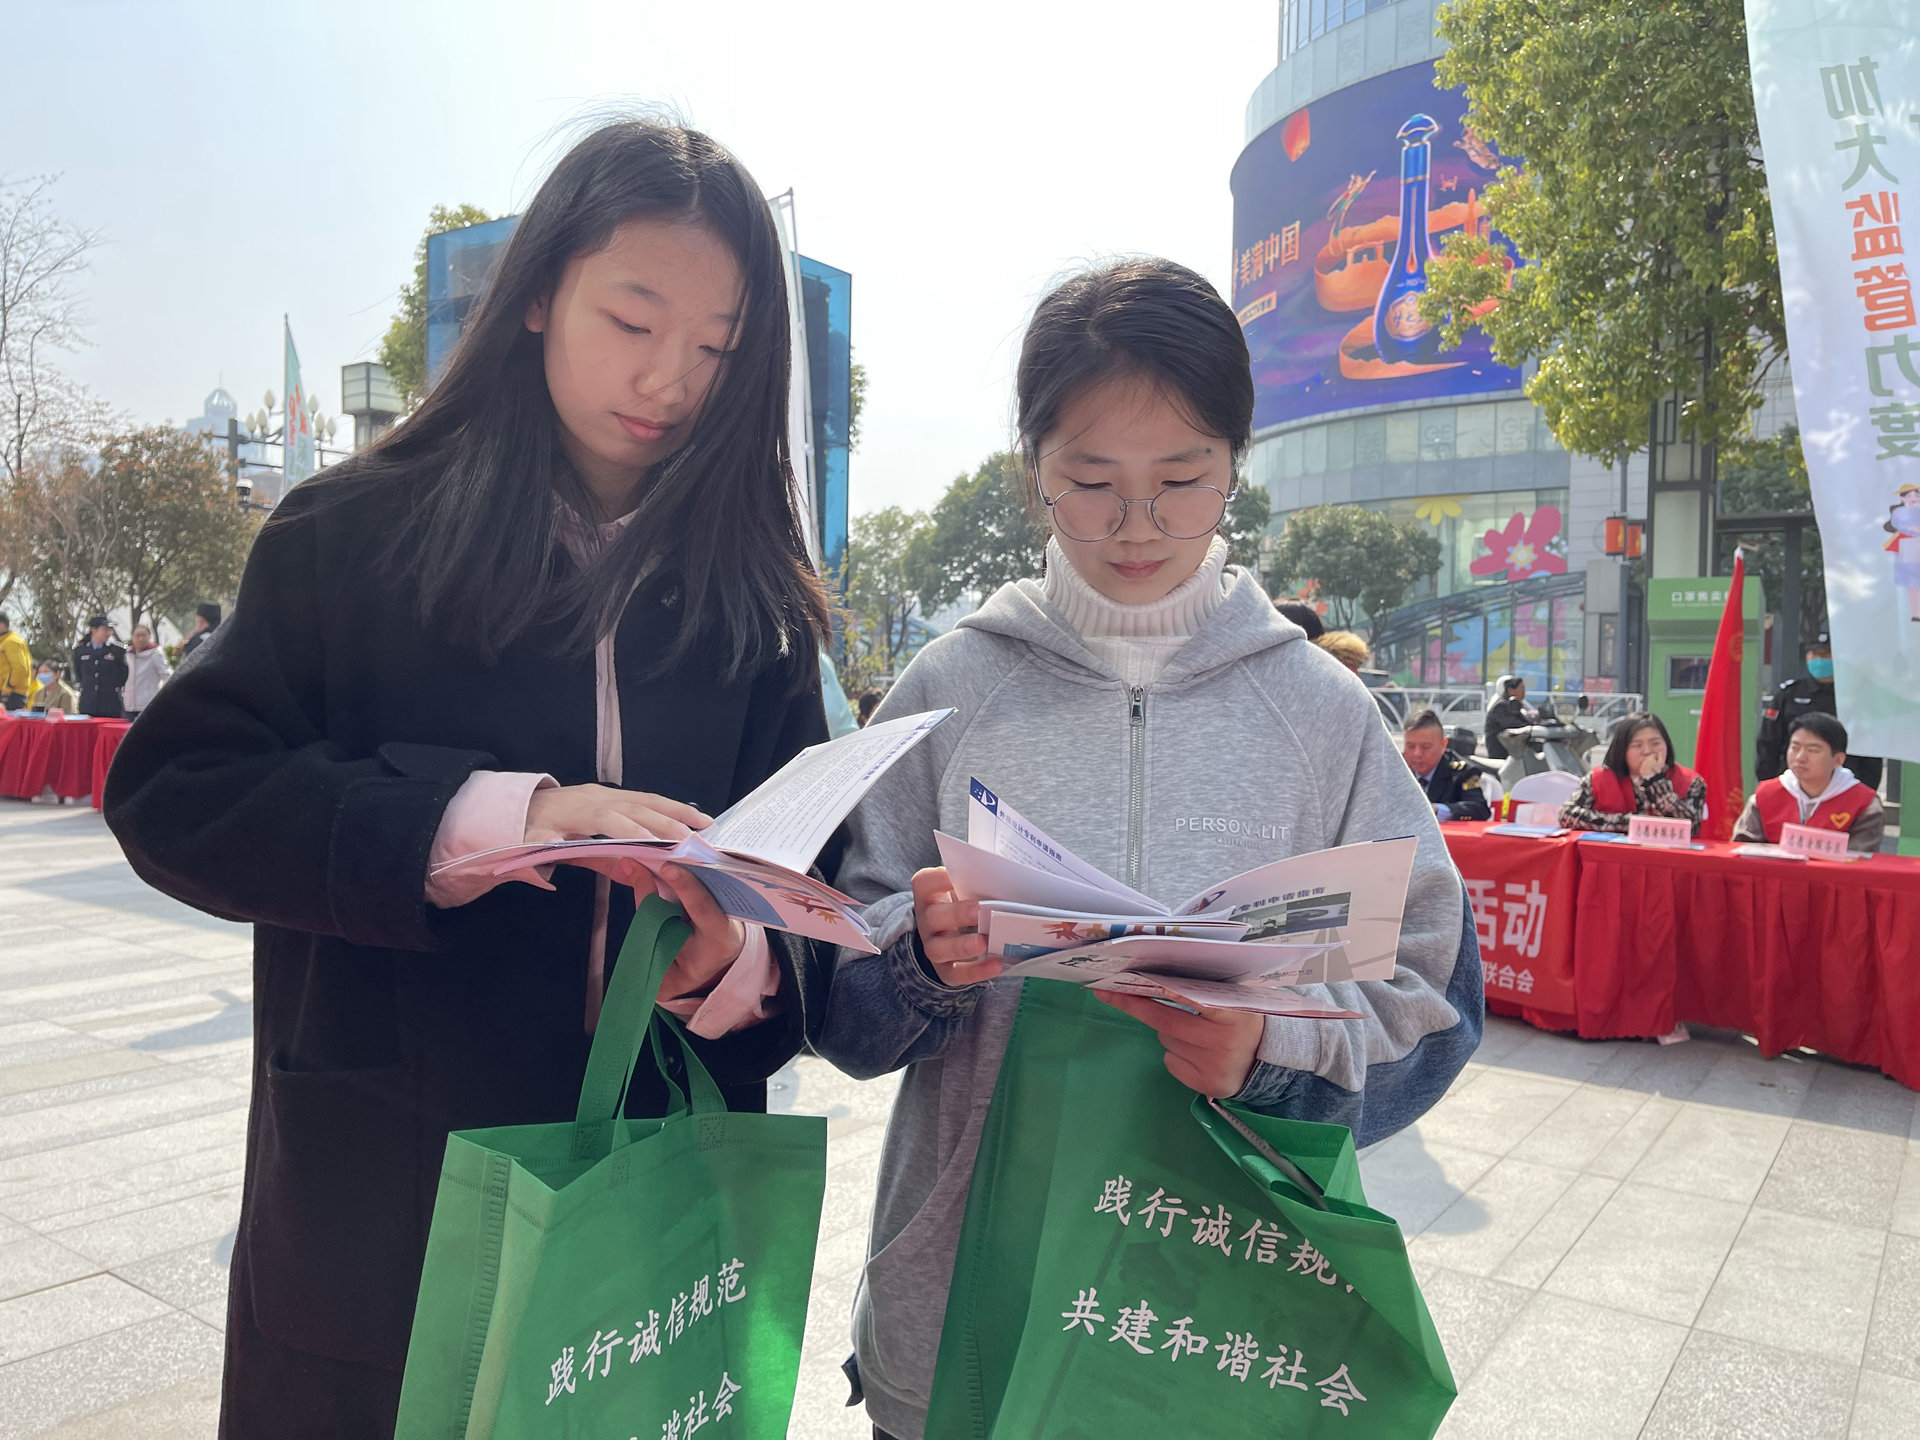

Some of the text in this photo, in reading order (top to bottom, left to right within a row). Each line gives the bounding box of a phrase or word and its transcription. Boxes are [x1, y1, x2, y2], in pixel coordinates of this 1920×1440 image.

[1463, 879, 1548, 958] 活动
[1481, 961, 1535, 994] 联合会
[1093, 1174, 1355, 1294] 践行诚信规
[544, 1257, 747, 1406] 践行诚信规范
[1061, 1286, 1368, 1417] 共建和谐社会
[630, 1371, 742, 1440] 谐社会
